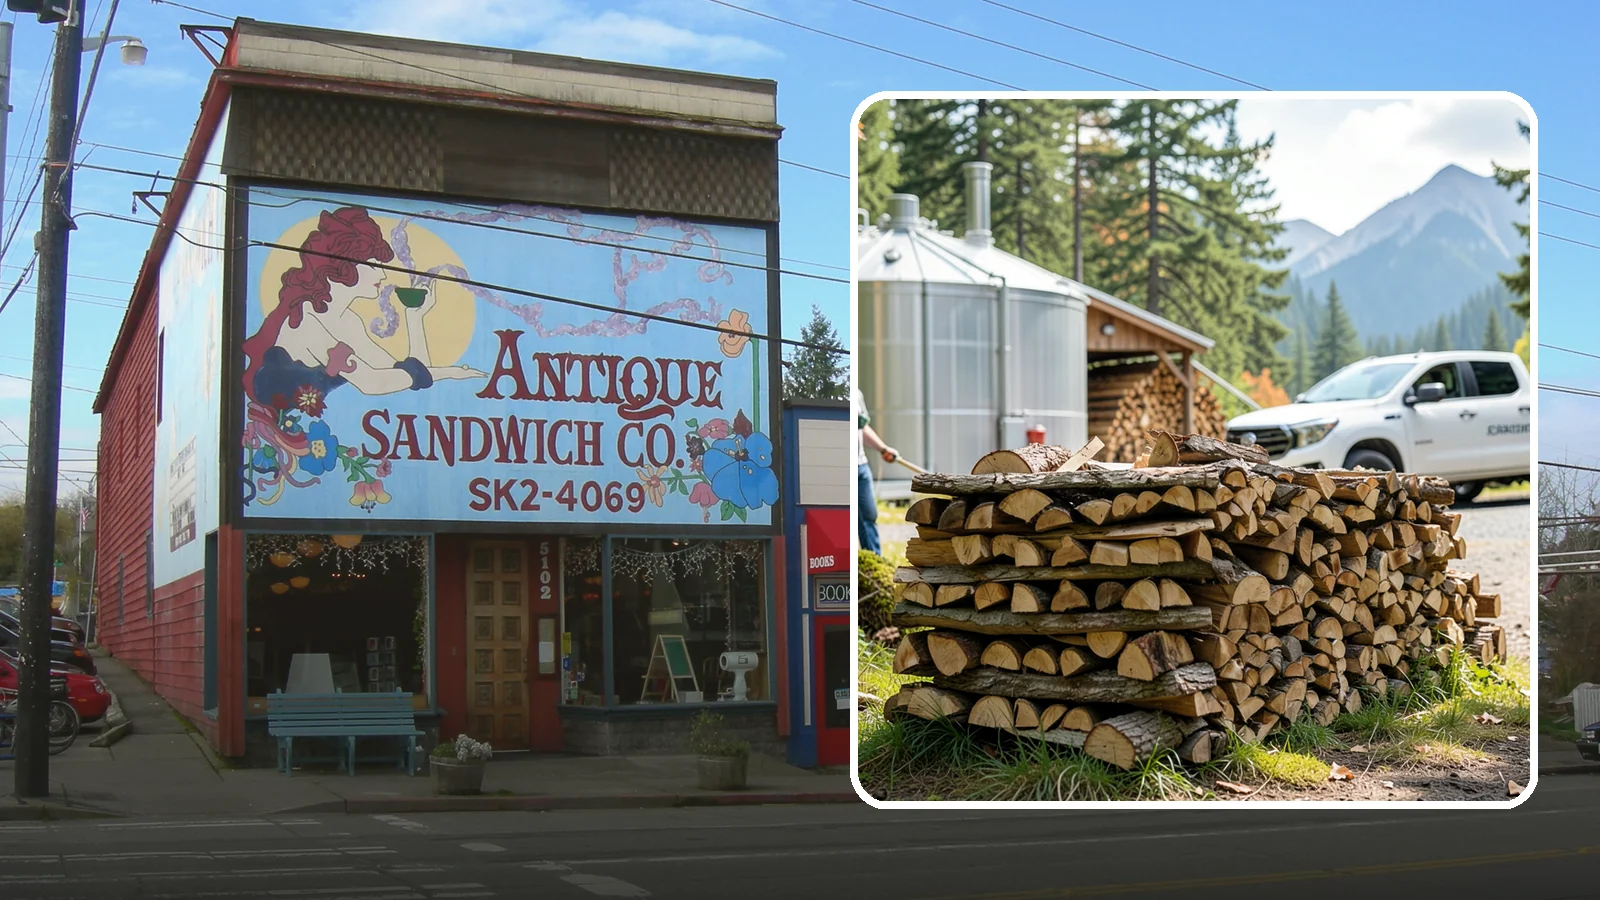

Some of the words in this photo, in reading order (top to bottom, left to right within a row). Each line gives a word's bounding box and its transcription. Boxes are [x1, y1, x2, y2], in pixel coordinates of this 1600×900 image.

[475, 329, 724, 420] ANTIQUE
[361, 408, 605, 467] SANDWICH
[617, 422, 685, 469] CO.
[469, 477, 645, 513] SK2-4069
[540, 541, 552, 600] 5102
[809, 555, 835, 569] BOOKS
